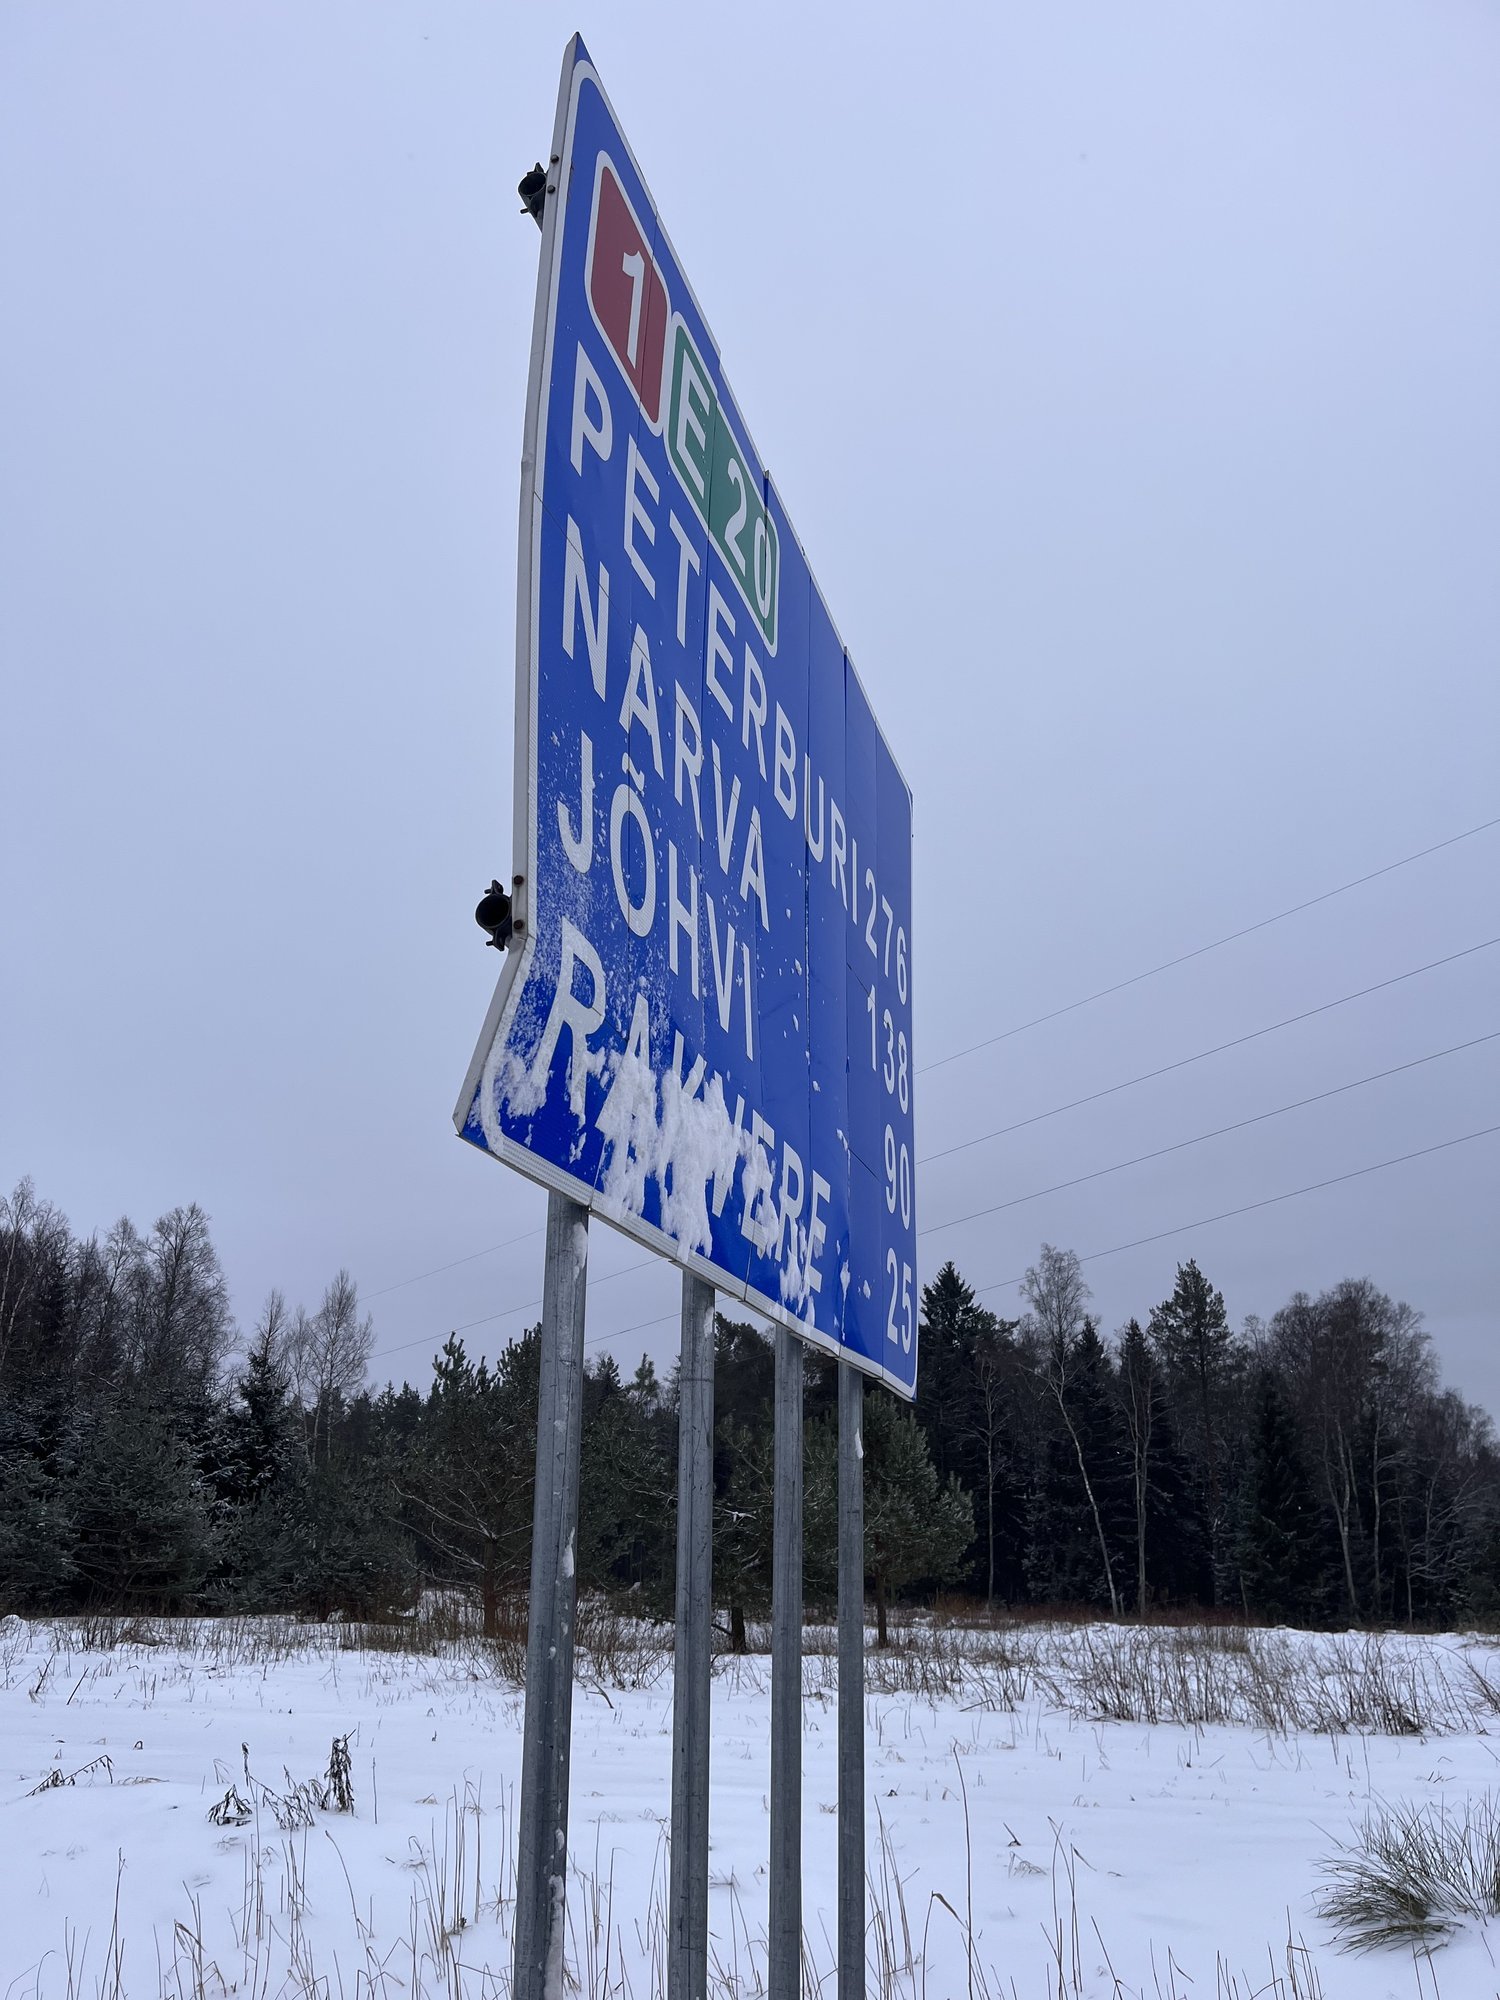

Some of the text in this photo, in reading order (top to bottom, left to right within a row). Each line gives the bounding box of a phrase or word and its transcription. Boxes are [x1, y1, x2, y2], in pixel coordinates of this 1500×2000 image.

[622, 250, 645, 369] 1
[676, 348, 773, 619] E 20
[570, 341, 908, 1005] PETERBURI 276
[562, 514, 908, 1115] NARVA 138
[884, 1123, 911, 1231] 90
[886, 1247, 912, 1355] 25
